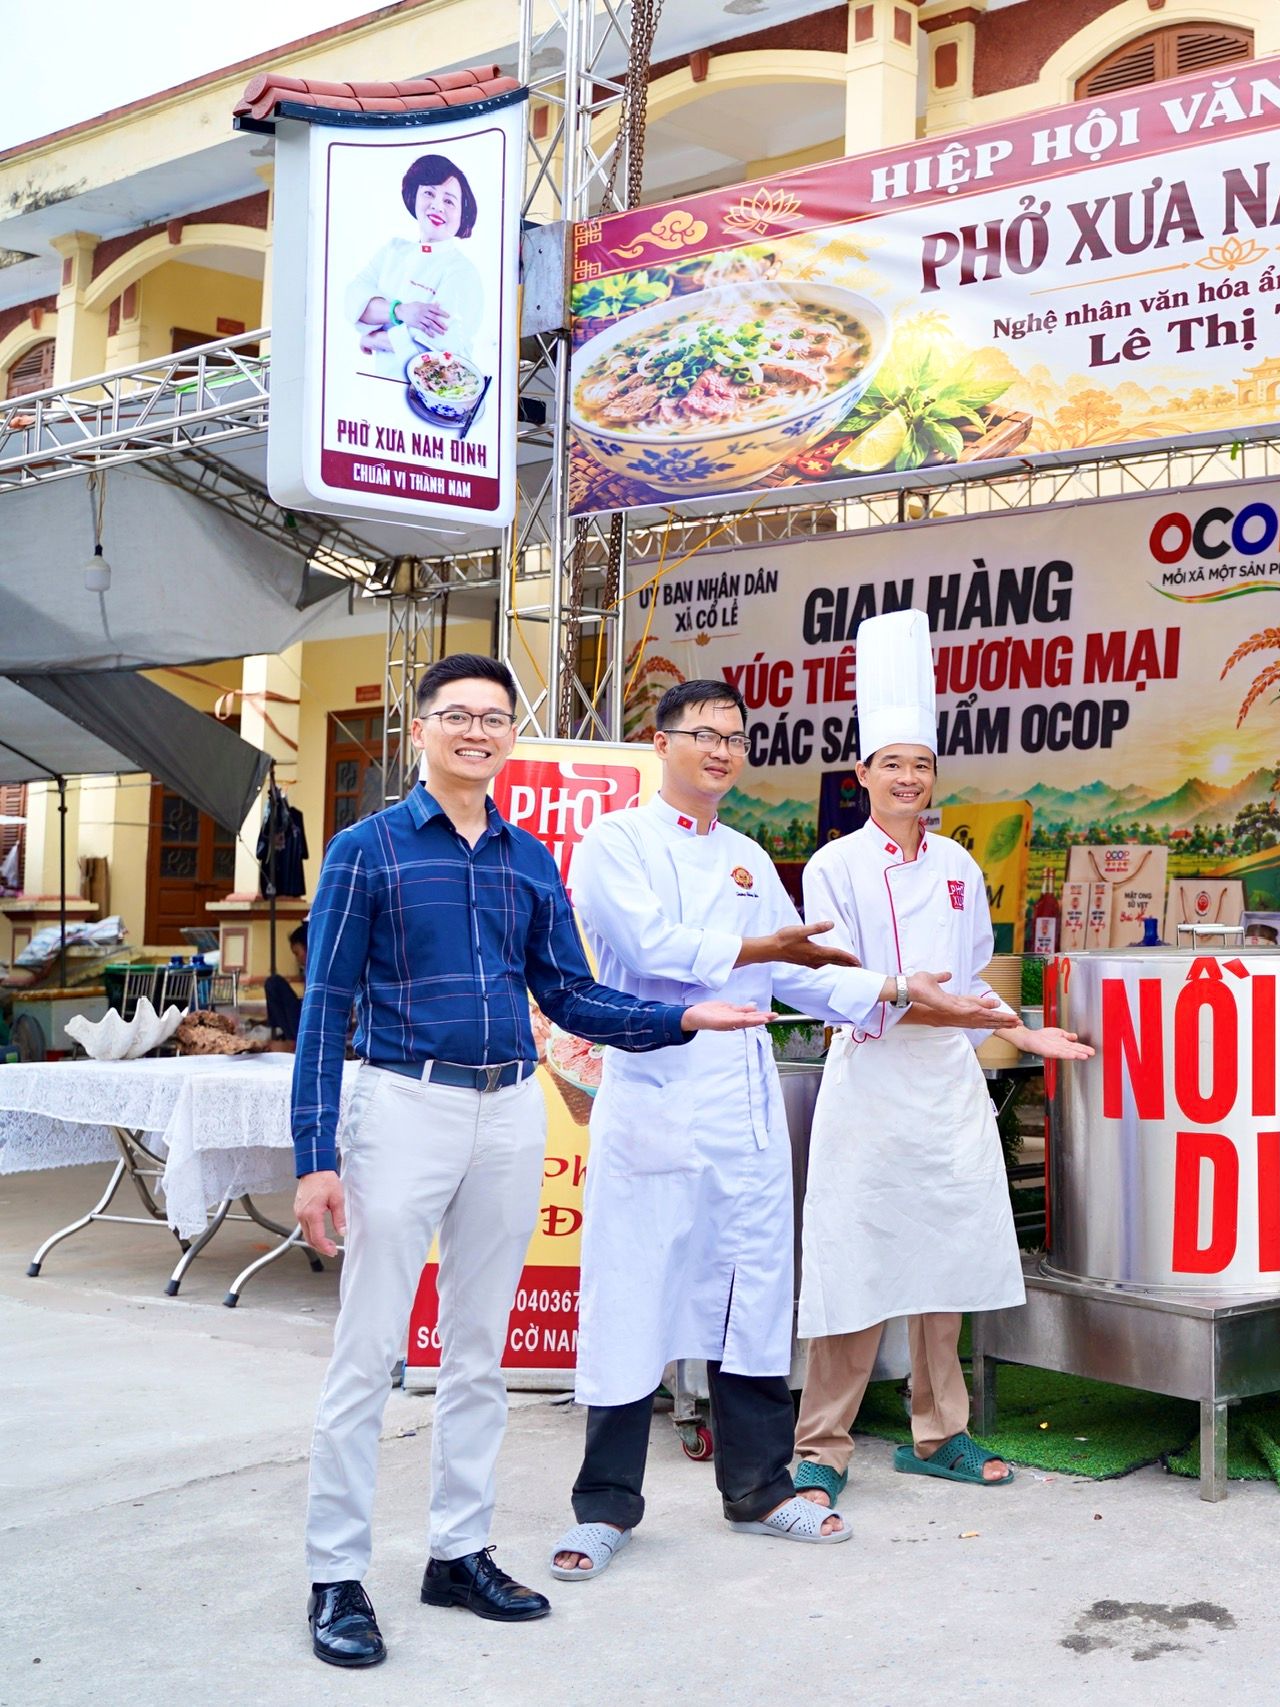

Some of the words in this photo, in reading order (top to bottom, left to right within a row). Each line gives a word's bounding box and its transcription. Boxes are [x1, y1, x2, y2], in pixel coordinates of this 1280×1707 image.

[870, 141, 1013, 203] HIỆP
[1031, 107, 1141, 166] HỘI
[920, 194, 1052, 294] PHỞ
[1065, 176, 1204, 266] XƯA
[993, 310, 1058, 341] Nghệ
[1065, 299, 1132, 327] nhân
[1139, 288, 1189, 313] văn
[1198, 277, 1250, 304] hóa
[1088, 327, 1152, 368] Lê
[1167, 307, 1258, 354] Thị
[337, 418, 370, 447] PHỞ
[375, 426, 406, 454] XƯA
[411, 432, 444, 460] NAM
[450, 439, 487, 469] ĐỊNH
[353, 462, 390, 486] CHUẨN
[393, 470, 406, 491] VỊ
[409, 471, 445, 495] THÀNH
[448, 478, 471, 499] NAM
[663, 581, 693, 606] BAN
[697, 571, 740, 601] NHÂN
[744, 567, 778, 596] DÂN
[803, 578, 914, 645] GIAN
[926, 558, 1073, 632] HÀNG
[1162, 567, 1186, 586] MỖI
[1188, 566, 1205, 583] XÃ
[1209, 564, 1236, 582] MỘT
[1239, 562, 1265, 577] SẢN
[722, 652, 794, 710] XÚC
[931, 635, 1073, 694] HƯƠNG
[1083, 626, 1181, 692] MẠI
[748, 711, 814, 767] CÁC
[1021, 699, 1130, 753] OCOP
[1102, 956, 1276, 1124] NỒI
